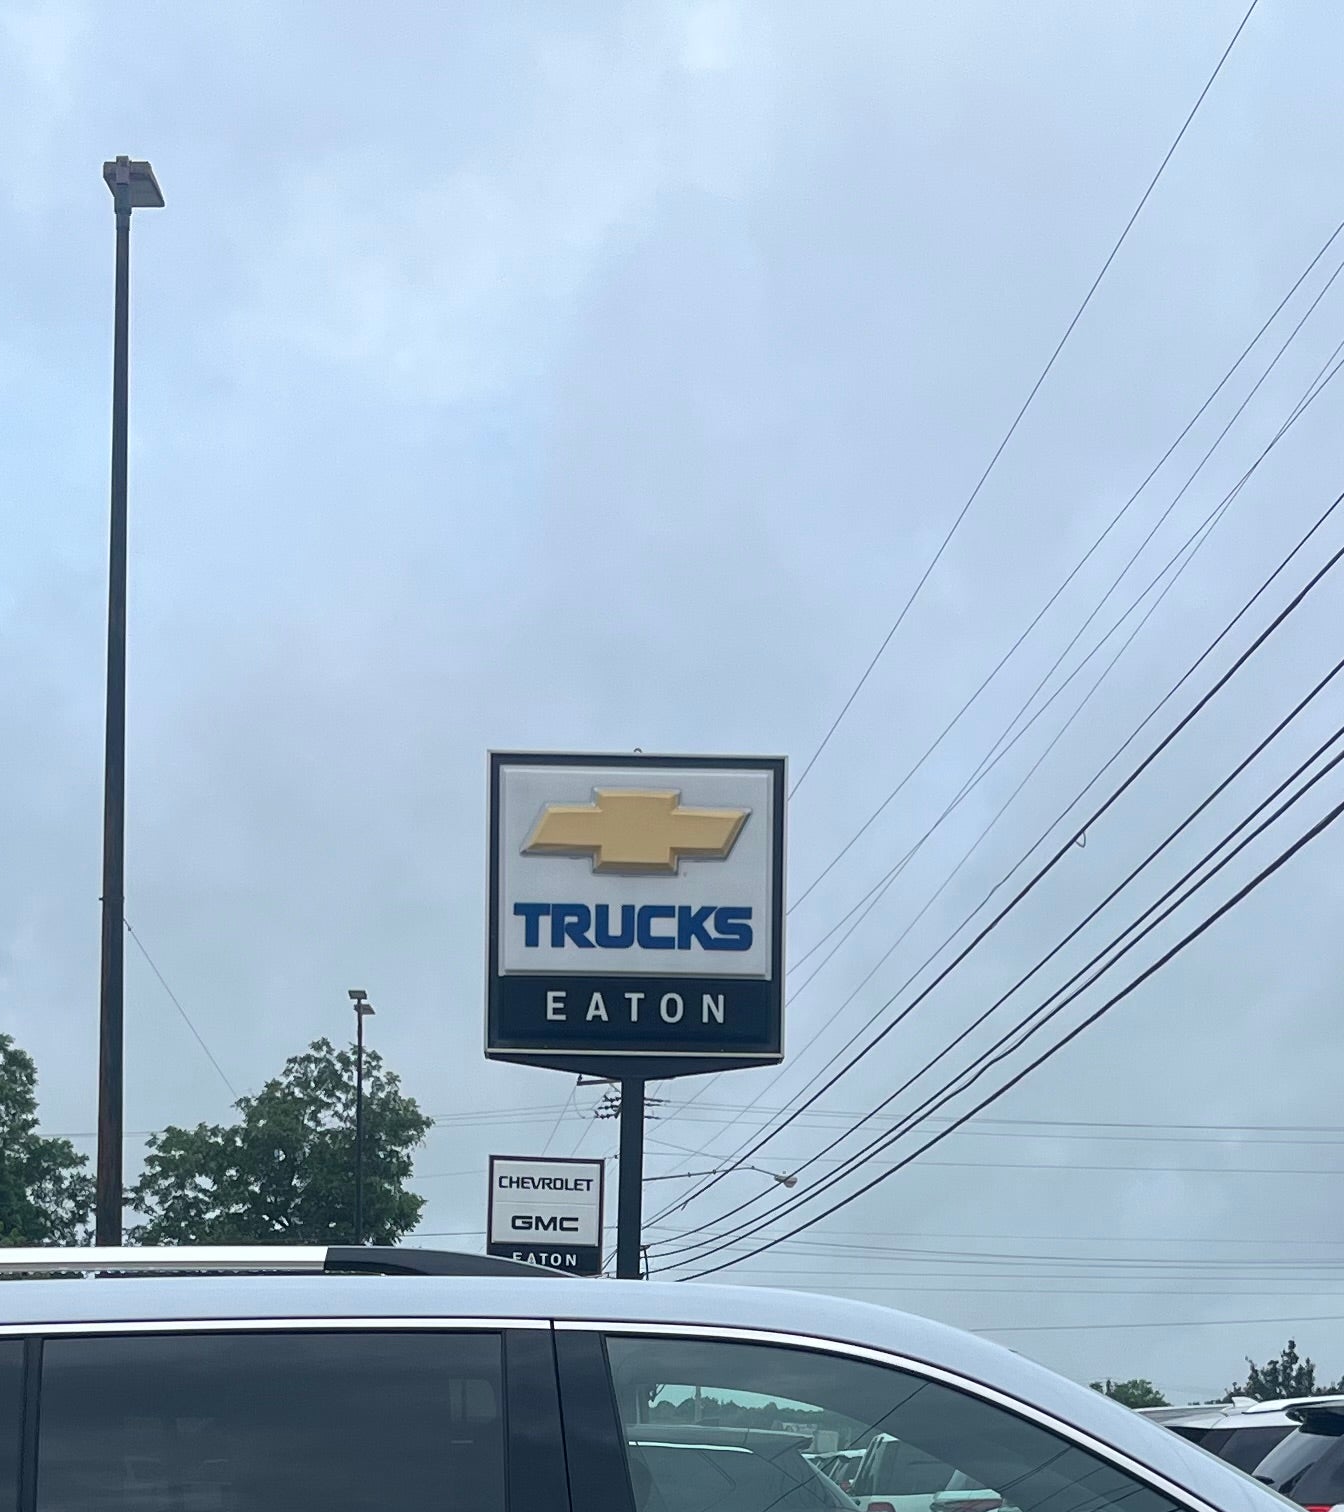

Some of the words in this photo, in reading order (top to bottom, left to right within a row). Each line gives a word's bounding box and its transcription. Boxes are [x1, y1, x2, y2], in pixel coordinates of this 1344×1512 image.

[513, 902, 753, 951] TRUCKS
[546, 991, 725, 1024] EATON
[498, 1175, 594, 1191] CHEVROLET
[511, 1215, 579, 1232] GMC
